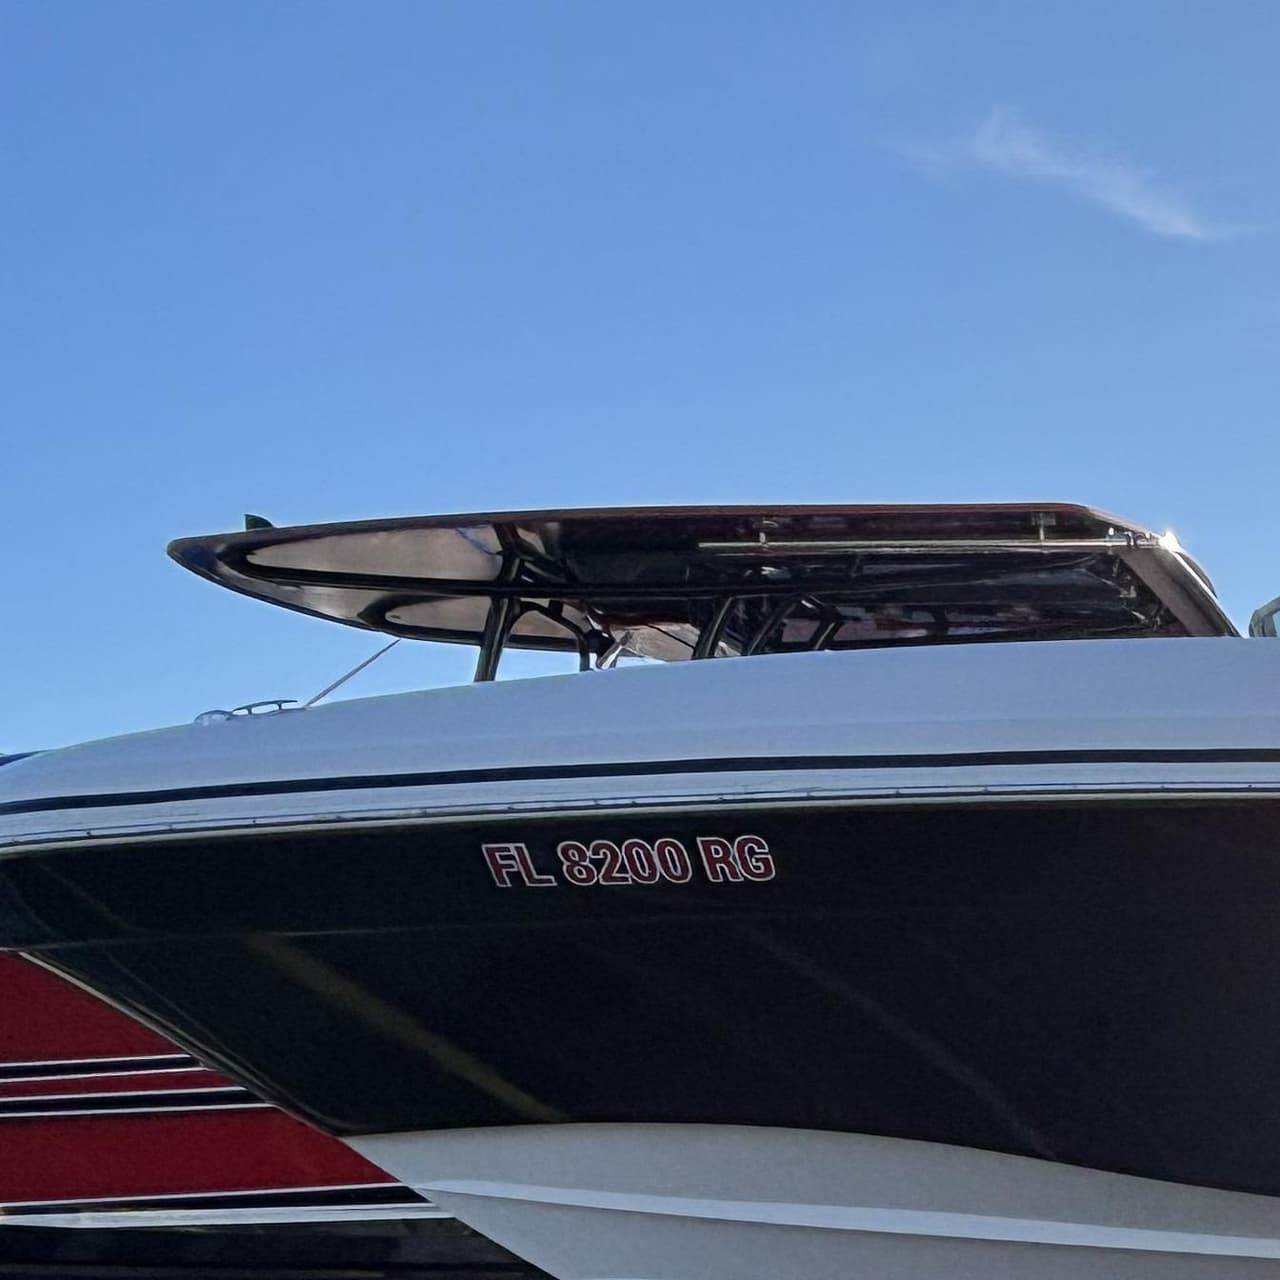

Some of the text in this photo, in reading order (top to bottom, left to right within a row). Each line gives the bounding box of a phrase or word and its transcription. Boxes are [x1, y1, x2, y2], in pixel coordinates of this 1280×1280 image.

[481, 835, 776, 887] FL 8200 RG
